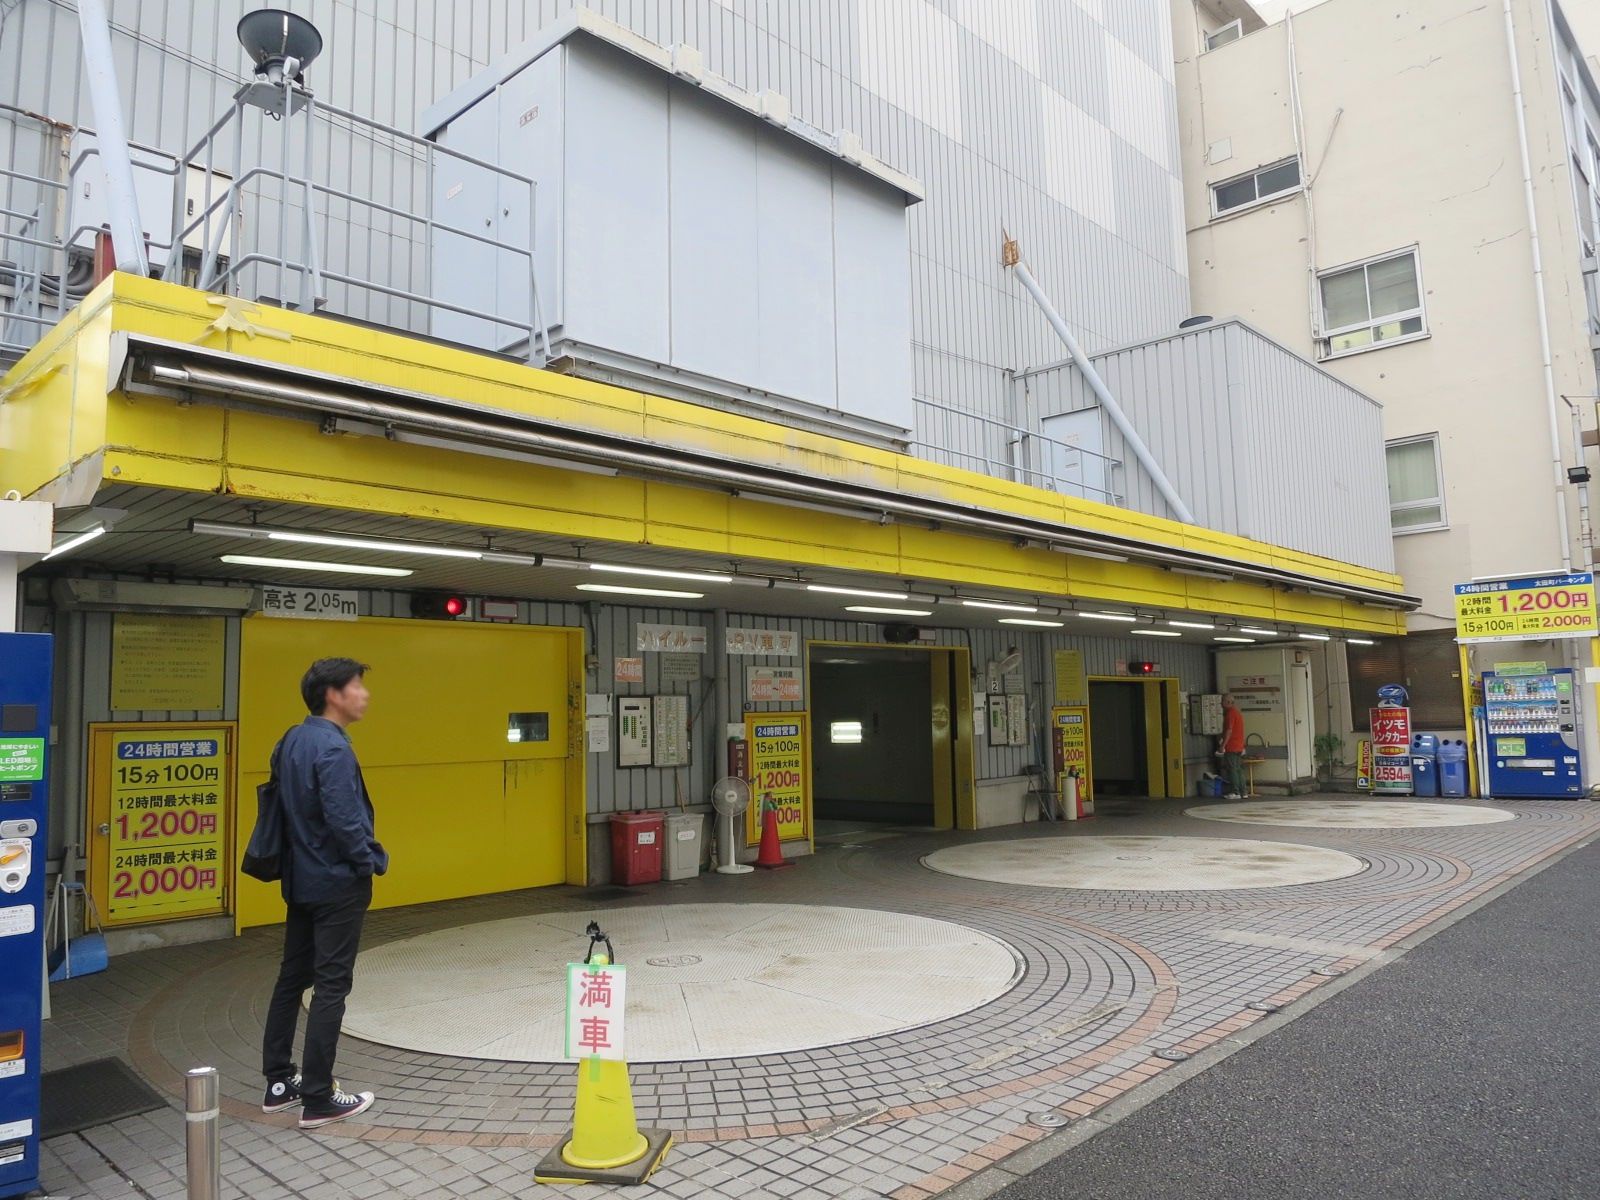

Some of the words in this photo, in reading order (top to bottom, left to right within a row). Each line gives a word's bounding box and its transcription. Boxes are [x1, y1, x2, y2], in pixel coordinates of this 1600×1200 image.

[1460, 582, 1508, 593] 24時間営業
[264, 589, 296, 609] 高さ
[304, 592, 357, 614] 2.05m
[1461, 596, 1491, 606] 12時間
[1498, 591, 1588, 613] 1,200円
[1461, 606, 1492, 616] 最大料金
[1542, 615, 1591, 628] 2,000円
[992, 682, 998, 691] 2
[757, 726, 797, 737] 24時間営業
[1374, 719, 1406, 730] イツモ
[1373, 732, 1408, 742] レンタカー
[123, 741, 213, 758] 24時間営業
[756, 760, 800, 770] 12時間最大料金
[756, 770, 801, 789] 1,200円
[118, 792, 218, 809] 12時間最大料金
[115, 809, 218, 841] 1,200円
[115, 848, 217, 868] 24時間最大料金
[114, 865, 217, 899] 2,000円
[579, 971, 613, 1053] 満車
